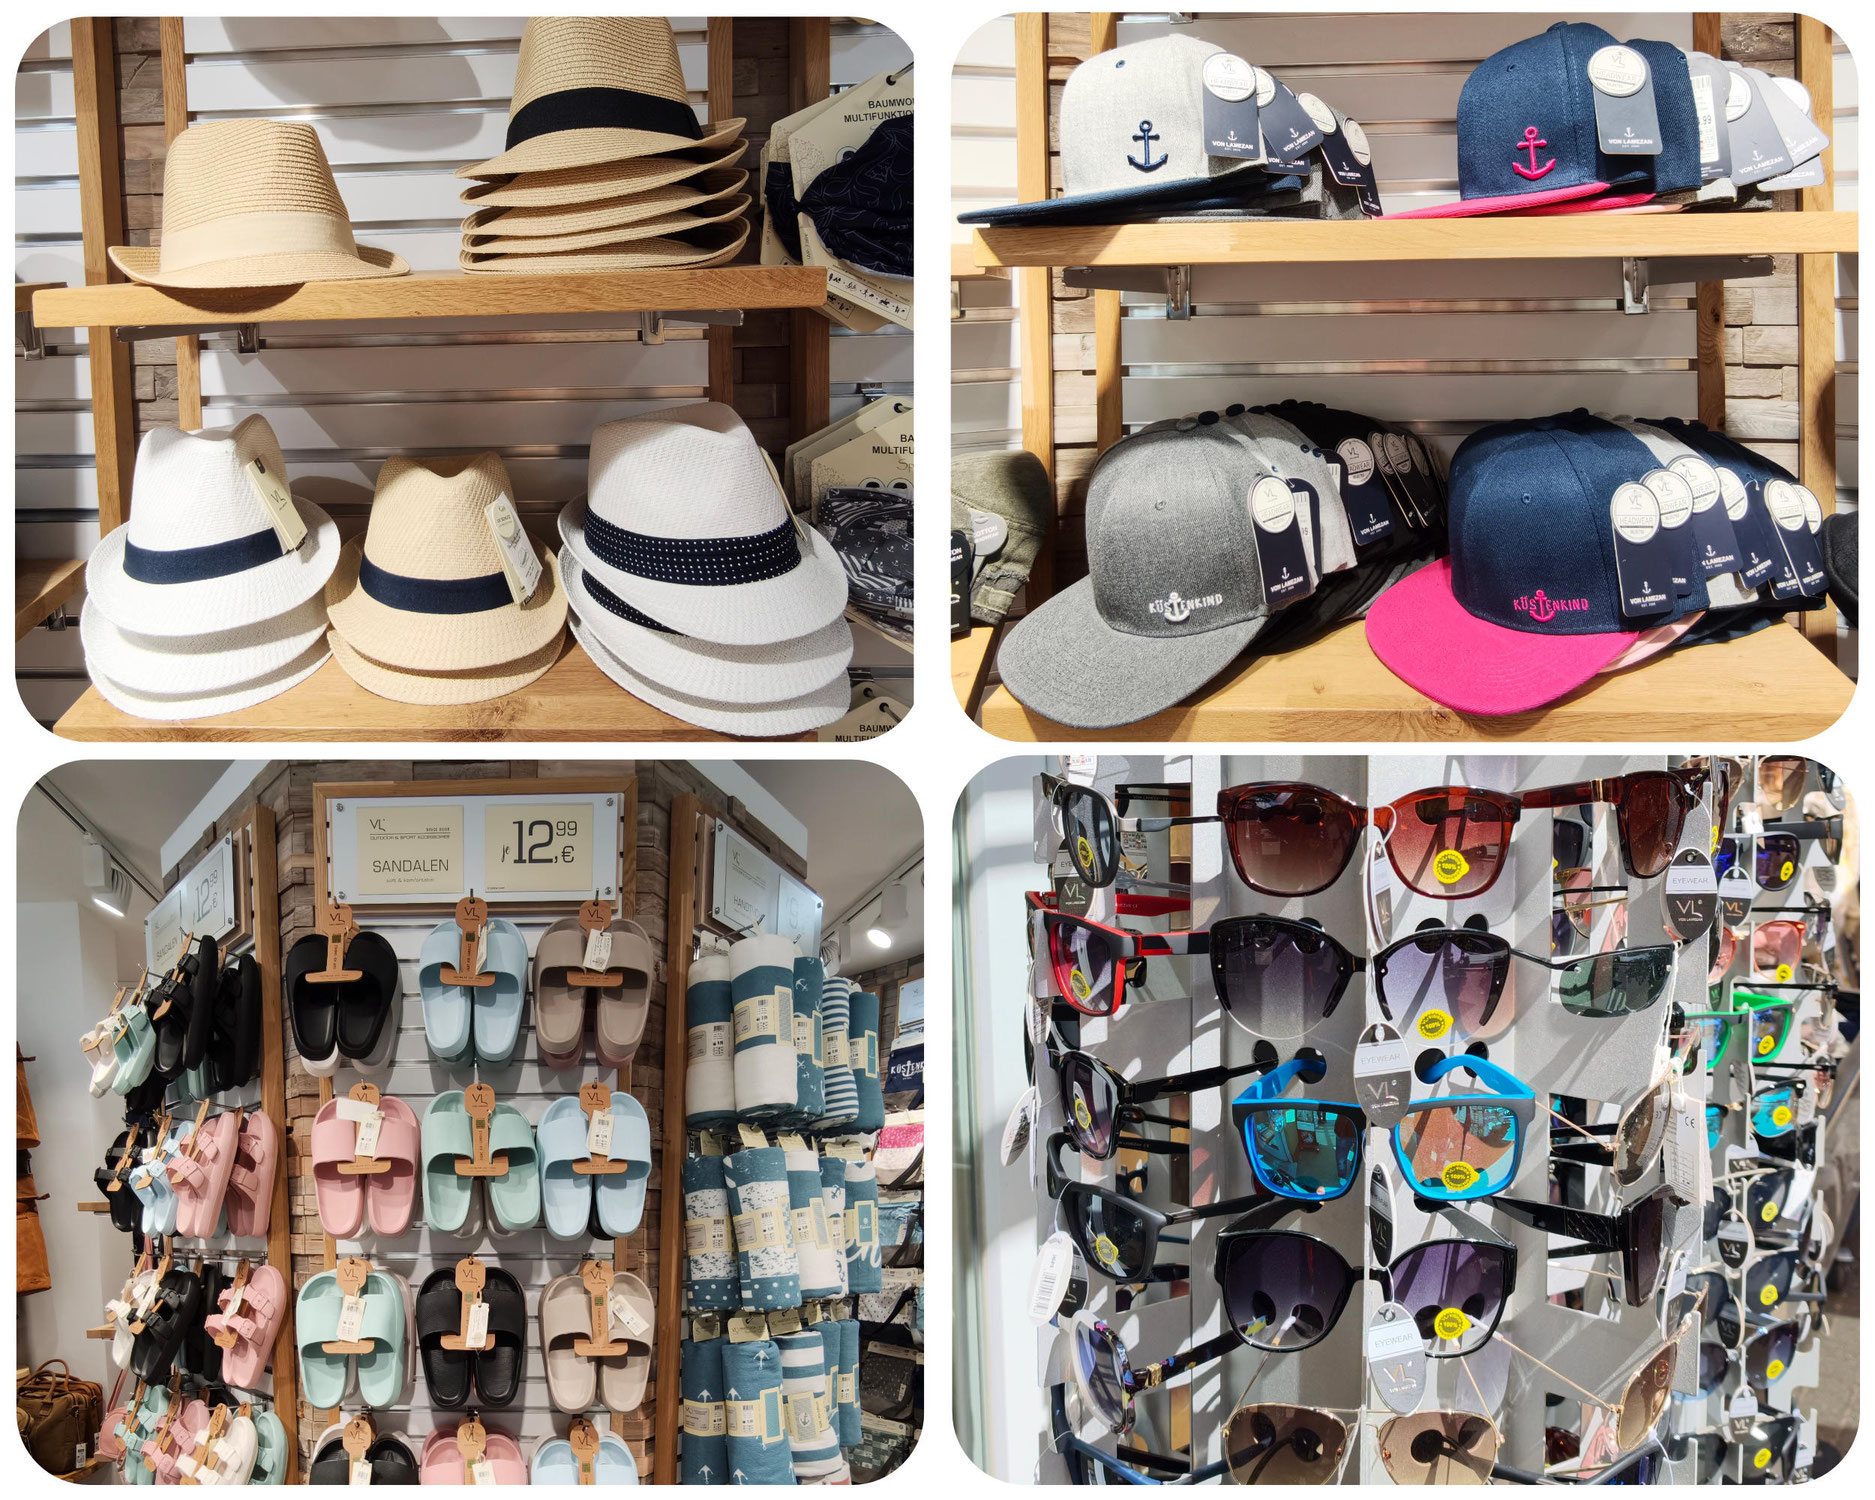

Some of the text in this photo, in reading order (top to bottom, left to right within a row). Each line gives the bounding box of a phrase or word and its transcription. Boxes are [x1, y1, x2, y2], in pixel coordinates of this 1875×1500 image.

[844, 109, 914, 123] MULTIFUNKTIO
[370, 818, 386, 832] VL
[373, 859, 449, 873] SANDALEN
[1672, 877, 1708, 885] EYEWEAR
[1064, 882, 1085, 900] VL
[463, 906, 480, 918] VL
[587, 909, 604, 920] VL
[1676, 900, 1703, 918] VL
[1725, 901, 1743, 915] VL
[329, 912, 346, 923] VL
[1361, 1053, 1401, 1065] EYEWEAR
[587, 1092, 603, 1103] VL
[1367, 1081, 1399, 1102] VL
[472, 1094, 488, 1105] VL
[343, 1268, 358, 1281] VL
[462, 1268, 478, 1280] VL
[590, 1271, 606, 1281] VL
[1374, 1332, 1414, 1349] EYEWEAR
[1384, 1363, 1416, 1384] VL
